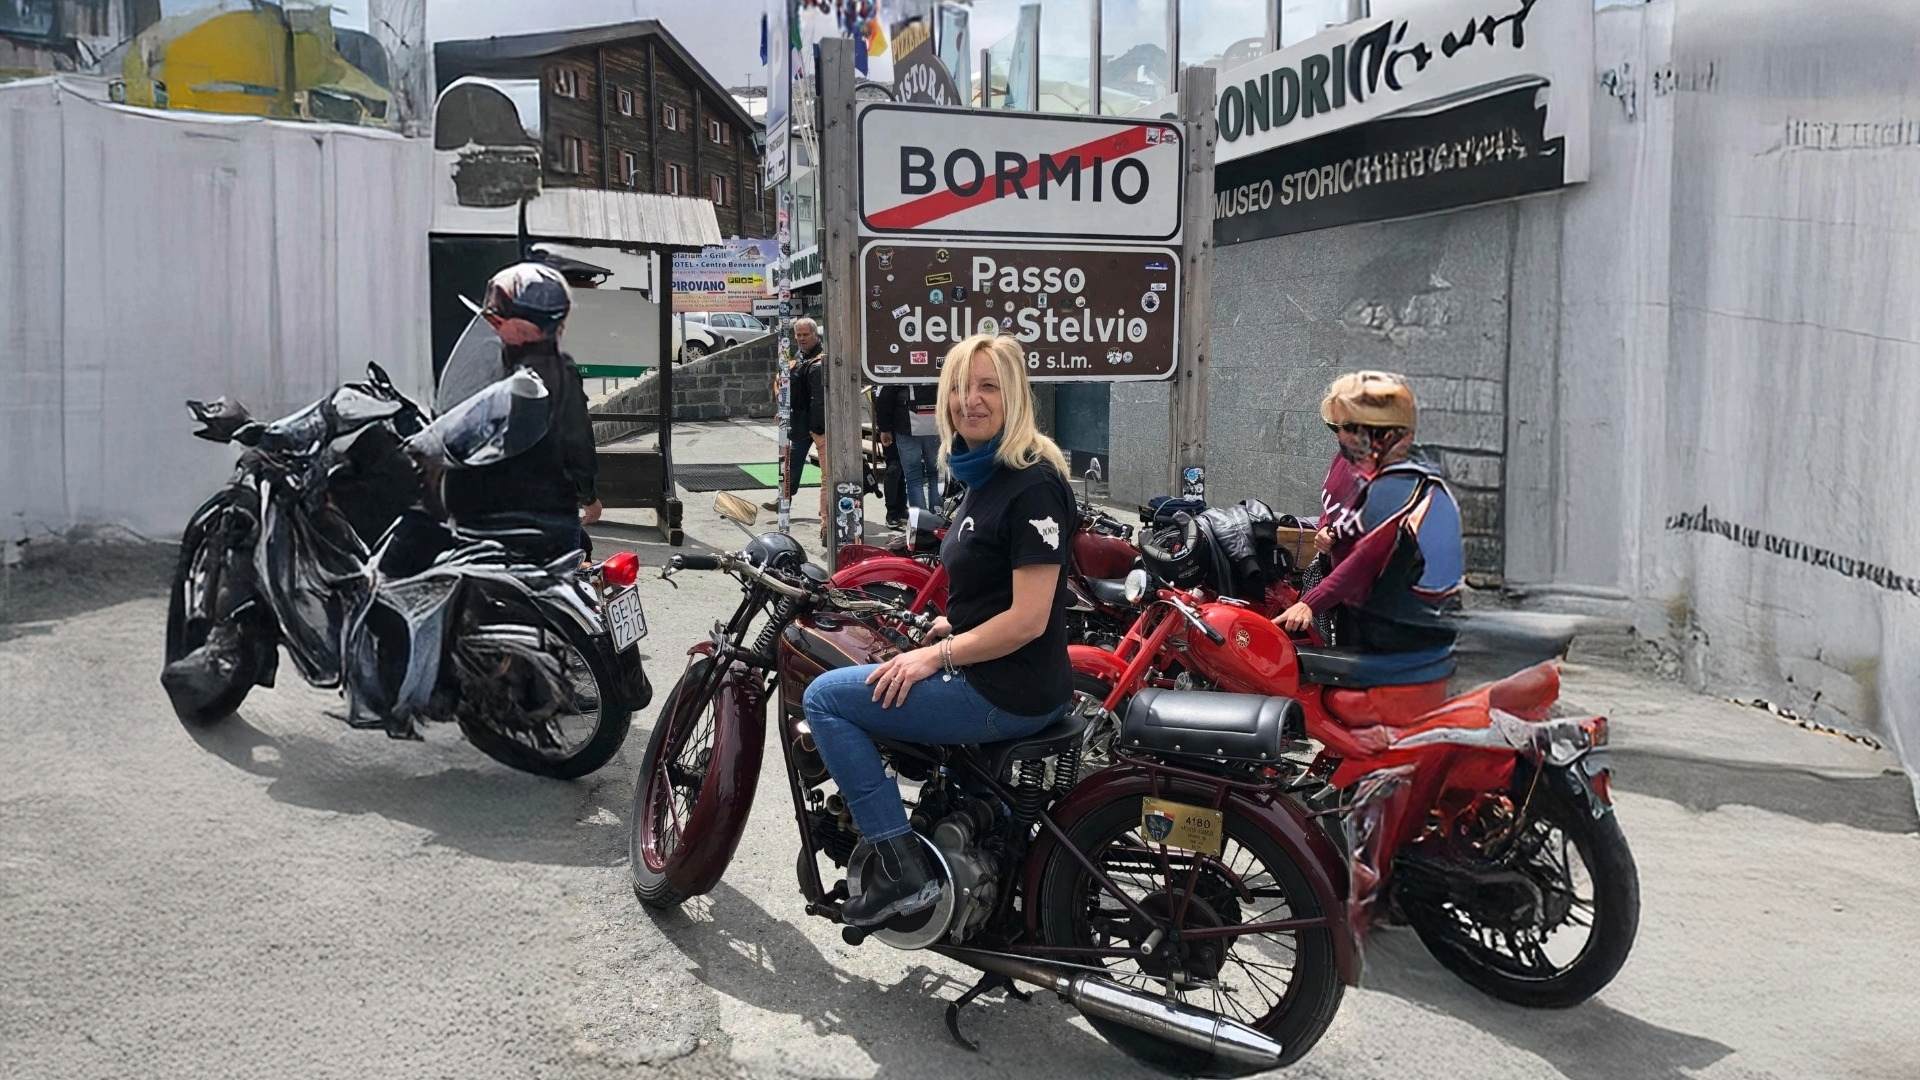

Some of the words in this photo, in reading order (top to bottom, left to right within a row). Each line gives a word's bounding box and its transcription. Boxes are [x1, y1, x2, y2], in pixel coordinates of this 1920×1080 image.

[896, 63, 952, 106] ISTORA
[899, 145, 1150, 205] BORMIO
[1213, 180, 1273, 219] MUSEO
[672, 280, 726, 292] PIROVANO
[972, 256, 1085, 294] Passo
[899, 306, 1000, 342] dello
[1015, 307, 1148, 343] Stelvio
[1046, 351, 1092, 369] s.l.m.
